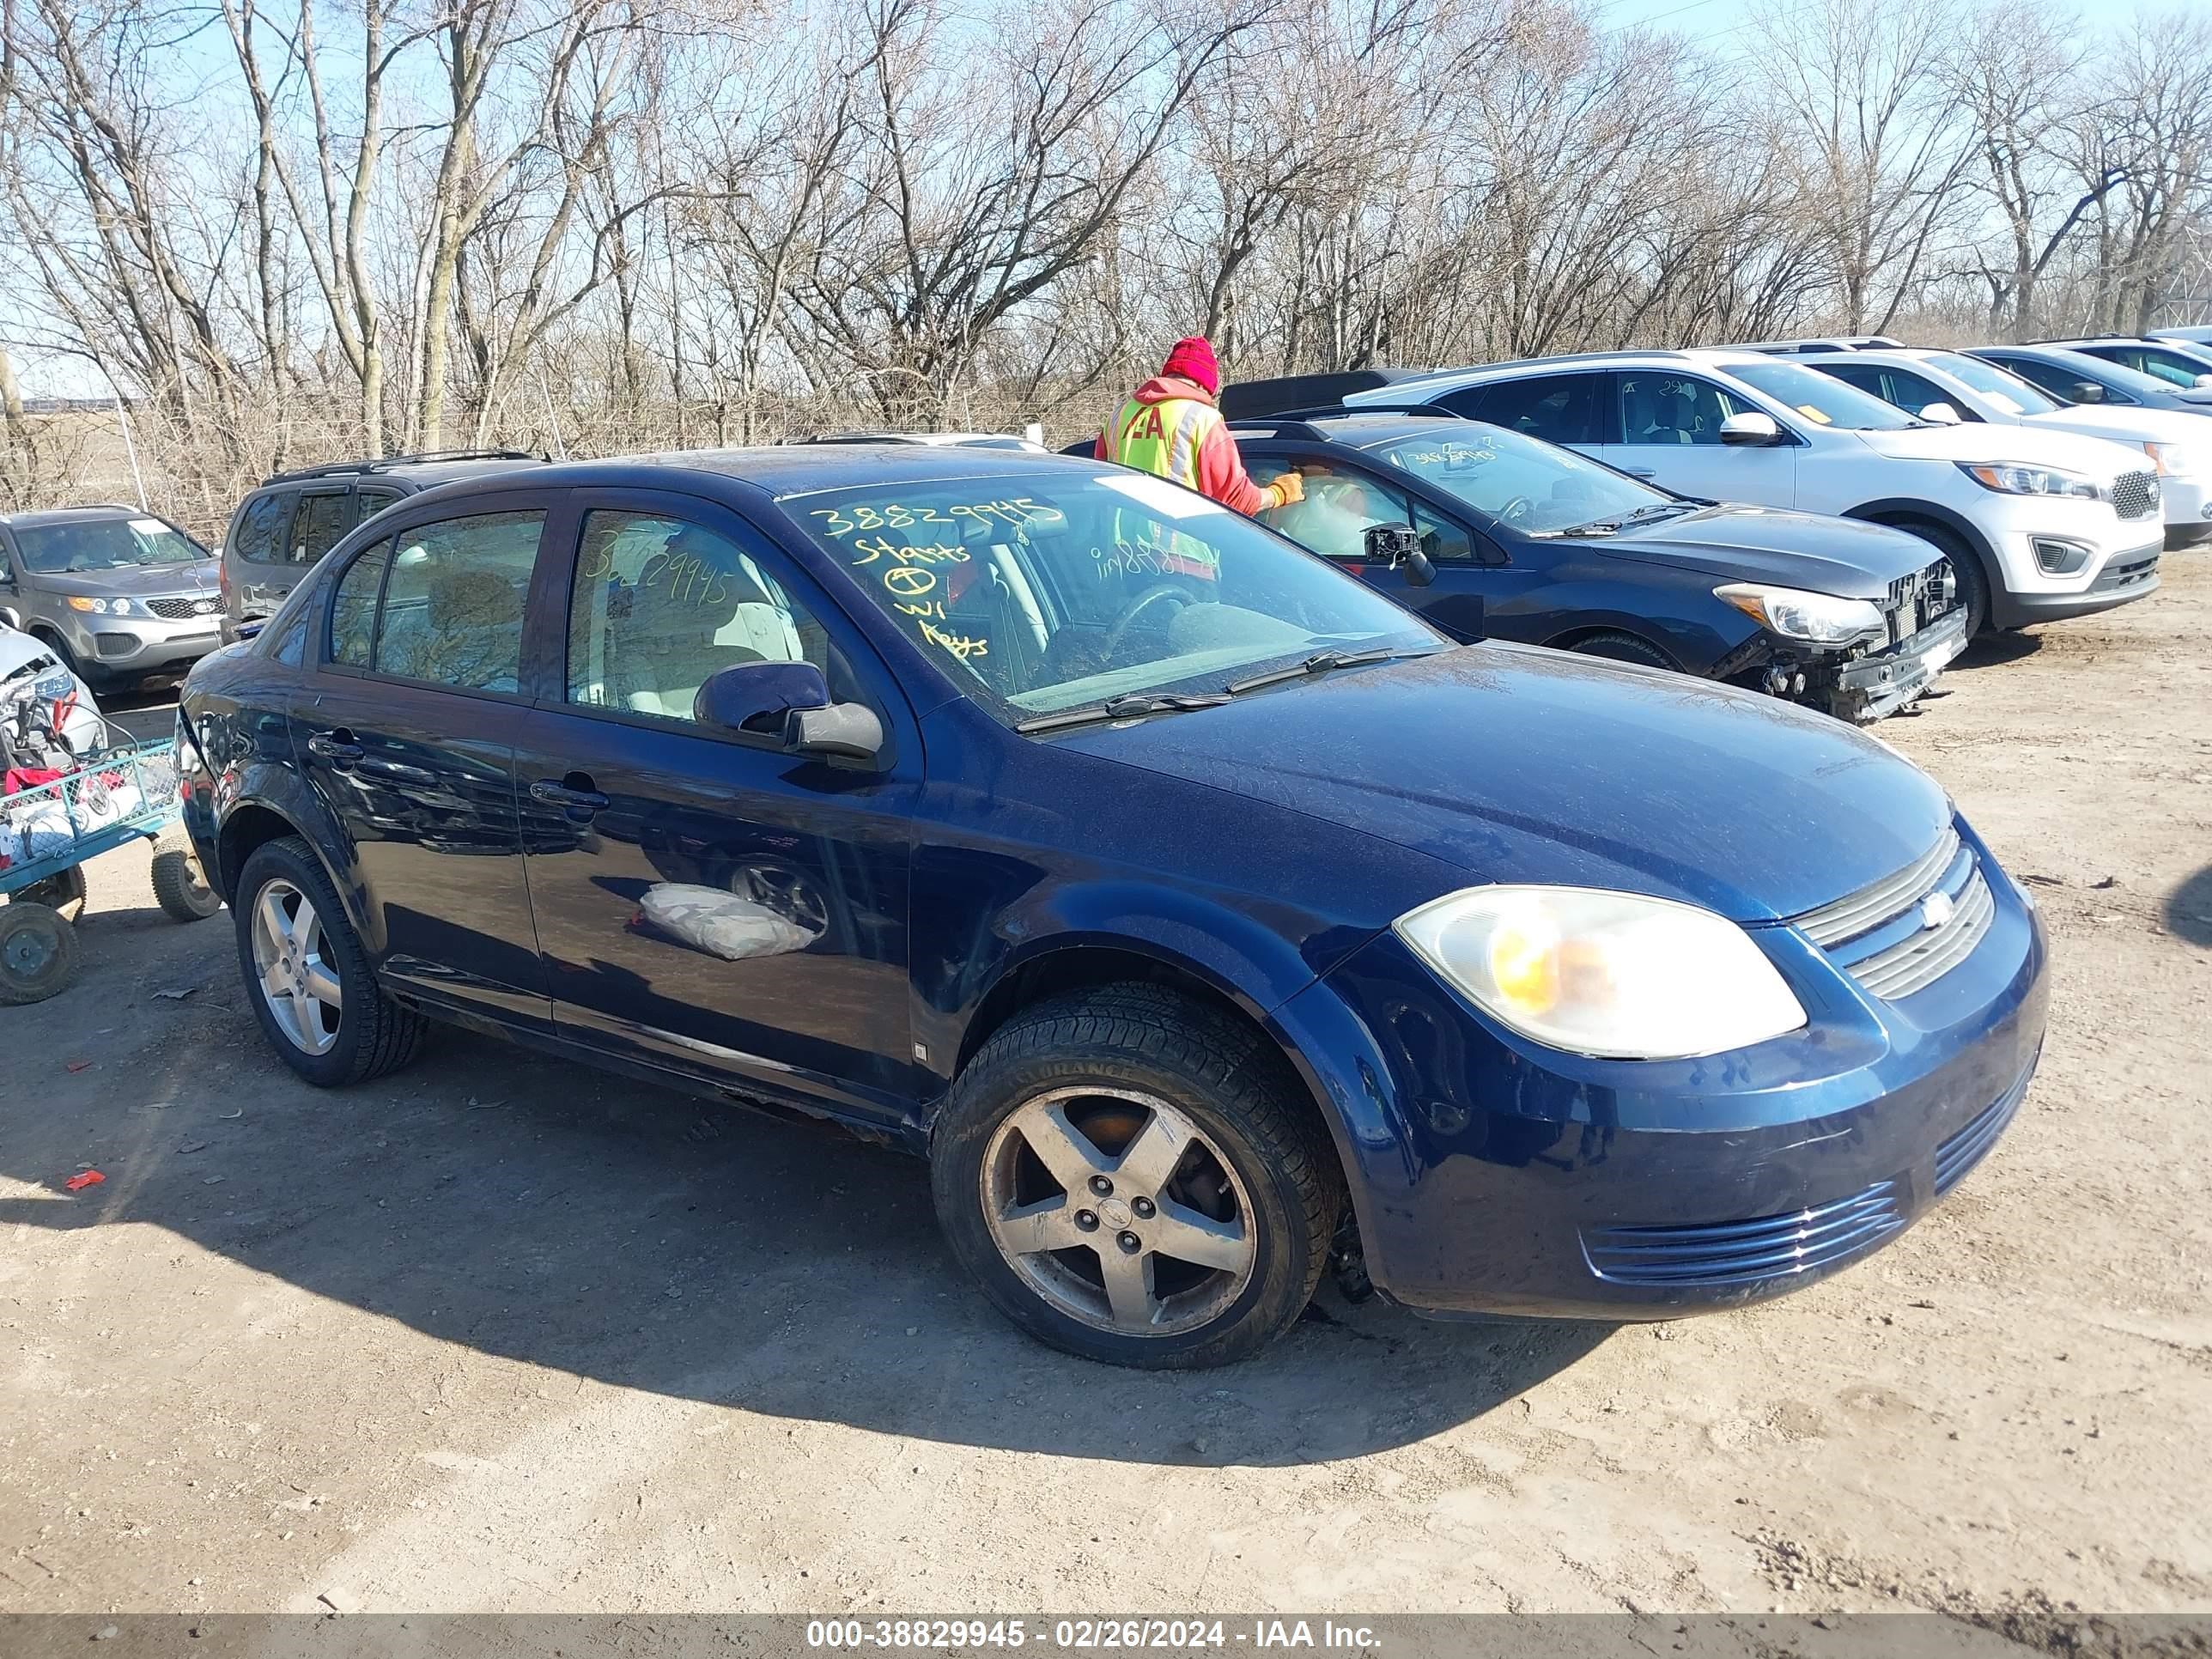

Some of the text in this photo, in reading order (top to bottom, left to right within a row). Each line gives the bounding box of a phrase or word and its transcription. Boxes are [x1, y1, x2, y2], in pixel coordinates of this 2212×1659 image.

[810, 498, 1064, 536] 38829945
[851, 536, 971, 566] Starts
[917, 619, 988, 659] Keys
